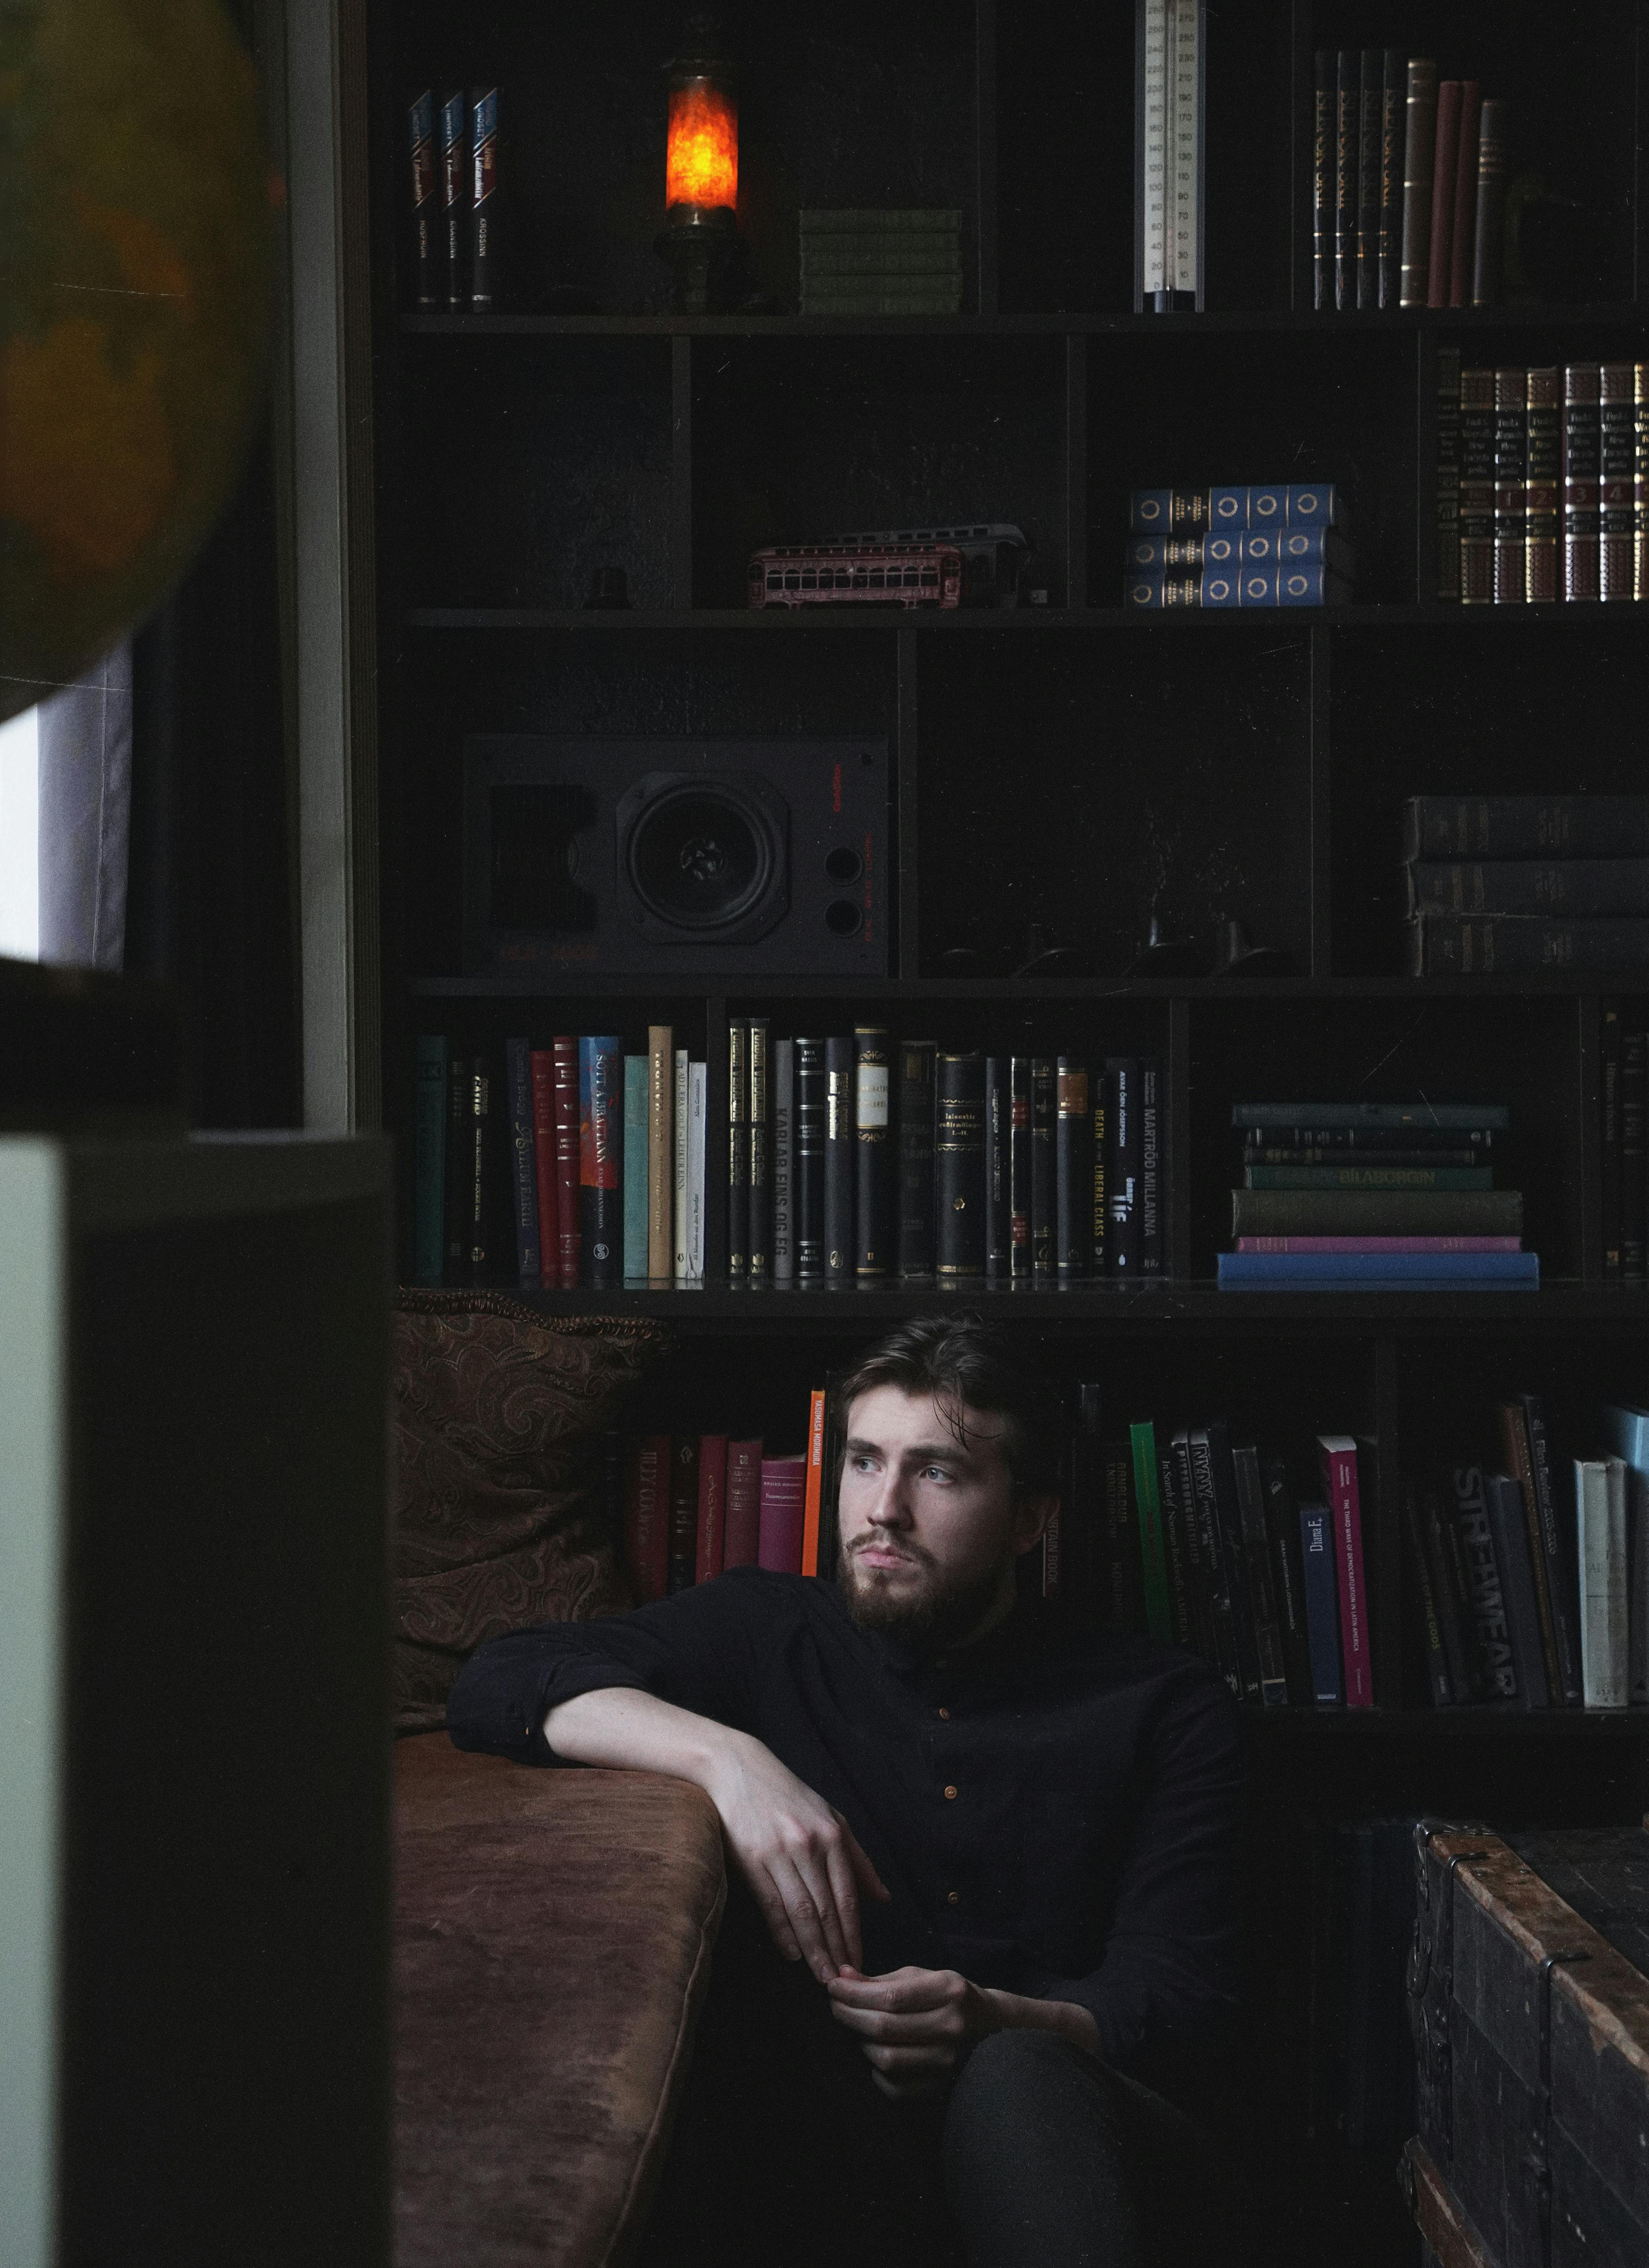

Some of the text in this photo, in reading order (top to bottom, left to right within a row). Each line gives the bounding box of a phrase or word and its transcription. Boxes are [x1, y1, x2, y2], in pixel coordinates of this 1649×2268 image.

[1178, 113, 1192, 122] 170
[1178, 172, 1190, 180] 110
[1178, 212, 1189, 220] 70
[478, 217, 487, 256] KROSSINN
[1180, 270, 1189, 279] 10
[1506, 491, 1511, 507] 1
[1535, 490, 1548, 506] 2
[1574, 486, 1587, 503] 3
[1610, 485, 1624, 501] 4
[1094, 1109, 1105, 1139] DEATH
[776, 1173, 788, 1207] EINS
[1094, 1165, 1105, 1203] LIBERAL
[1144, 1171, 1156, 1236] MILLANNA
[1094, 1207, 1105, 1237] CLASS
[813, 1400, 823, 1466] YASUMASA MORIMURA
[1162, 1470, 1176, 1497] Search
[1167, 1510, 1179, 1546] Norman
[1310, 1527, 1323, 1552] Diana
[1048, 1554, 1059, 1584] BOOK
[1347, 1552, 1356, 1603] DEMOCRATIZATION
[1428, 1620, 1441, 1653] GODS
